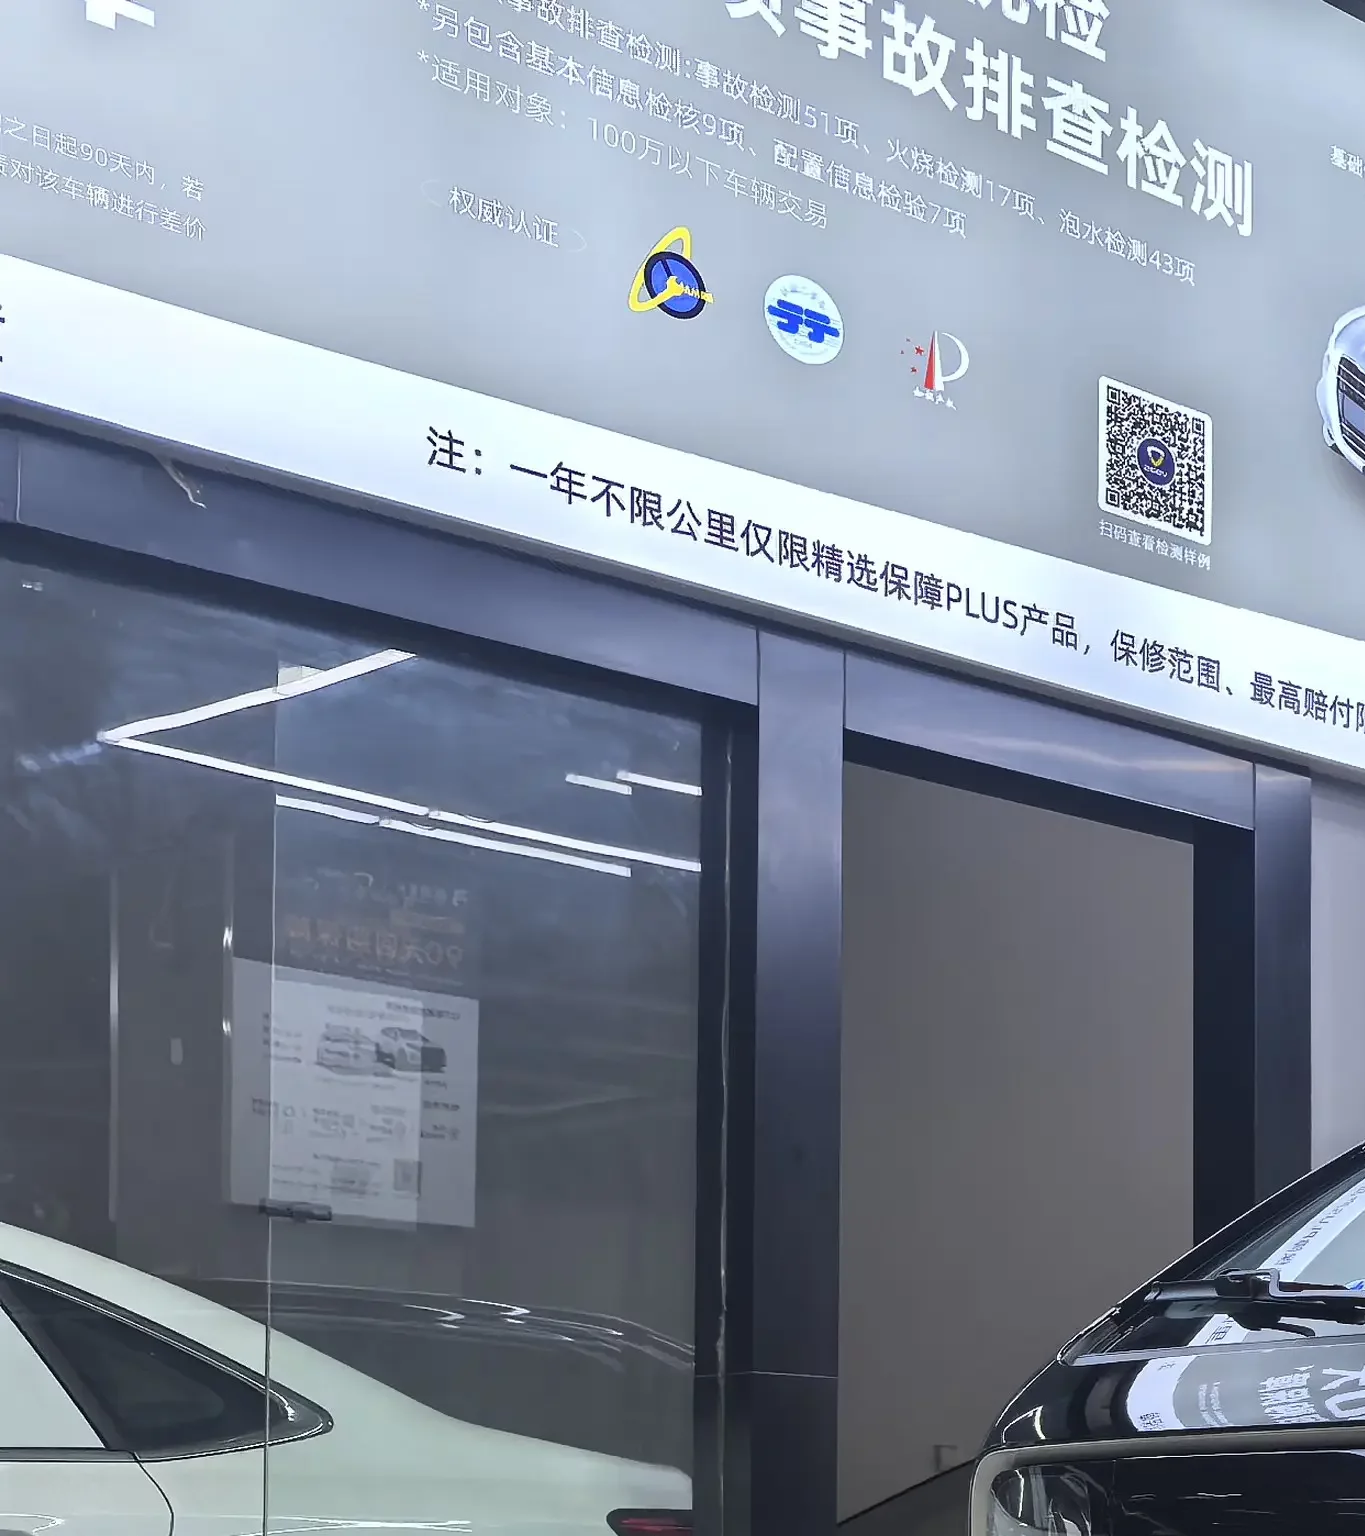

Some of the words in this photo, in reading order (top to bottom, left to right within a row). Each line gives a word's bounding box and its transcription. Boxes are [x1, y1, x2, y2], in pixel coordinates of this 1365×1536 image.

[0, 114, 203, 201] 之日起90天内，若
[449, 186, 559, 248] 权威认证
